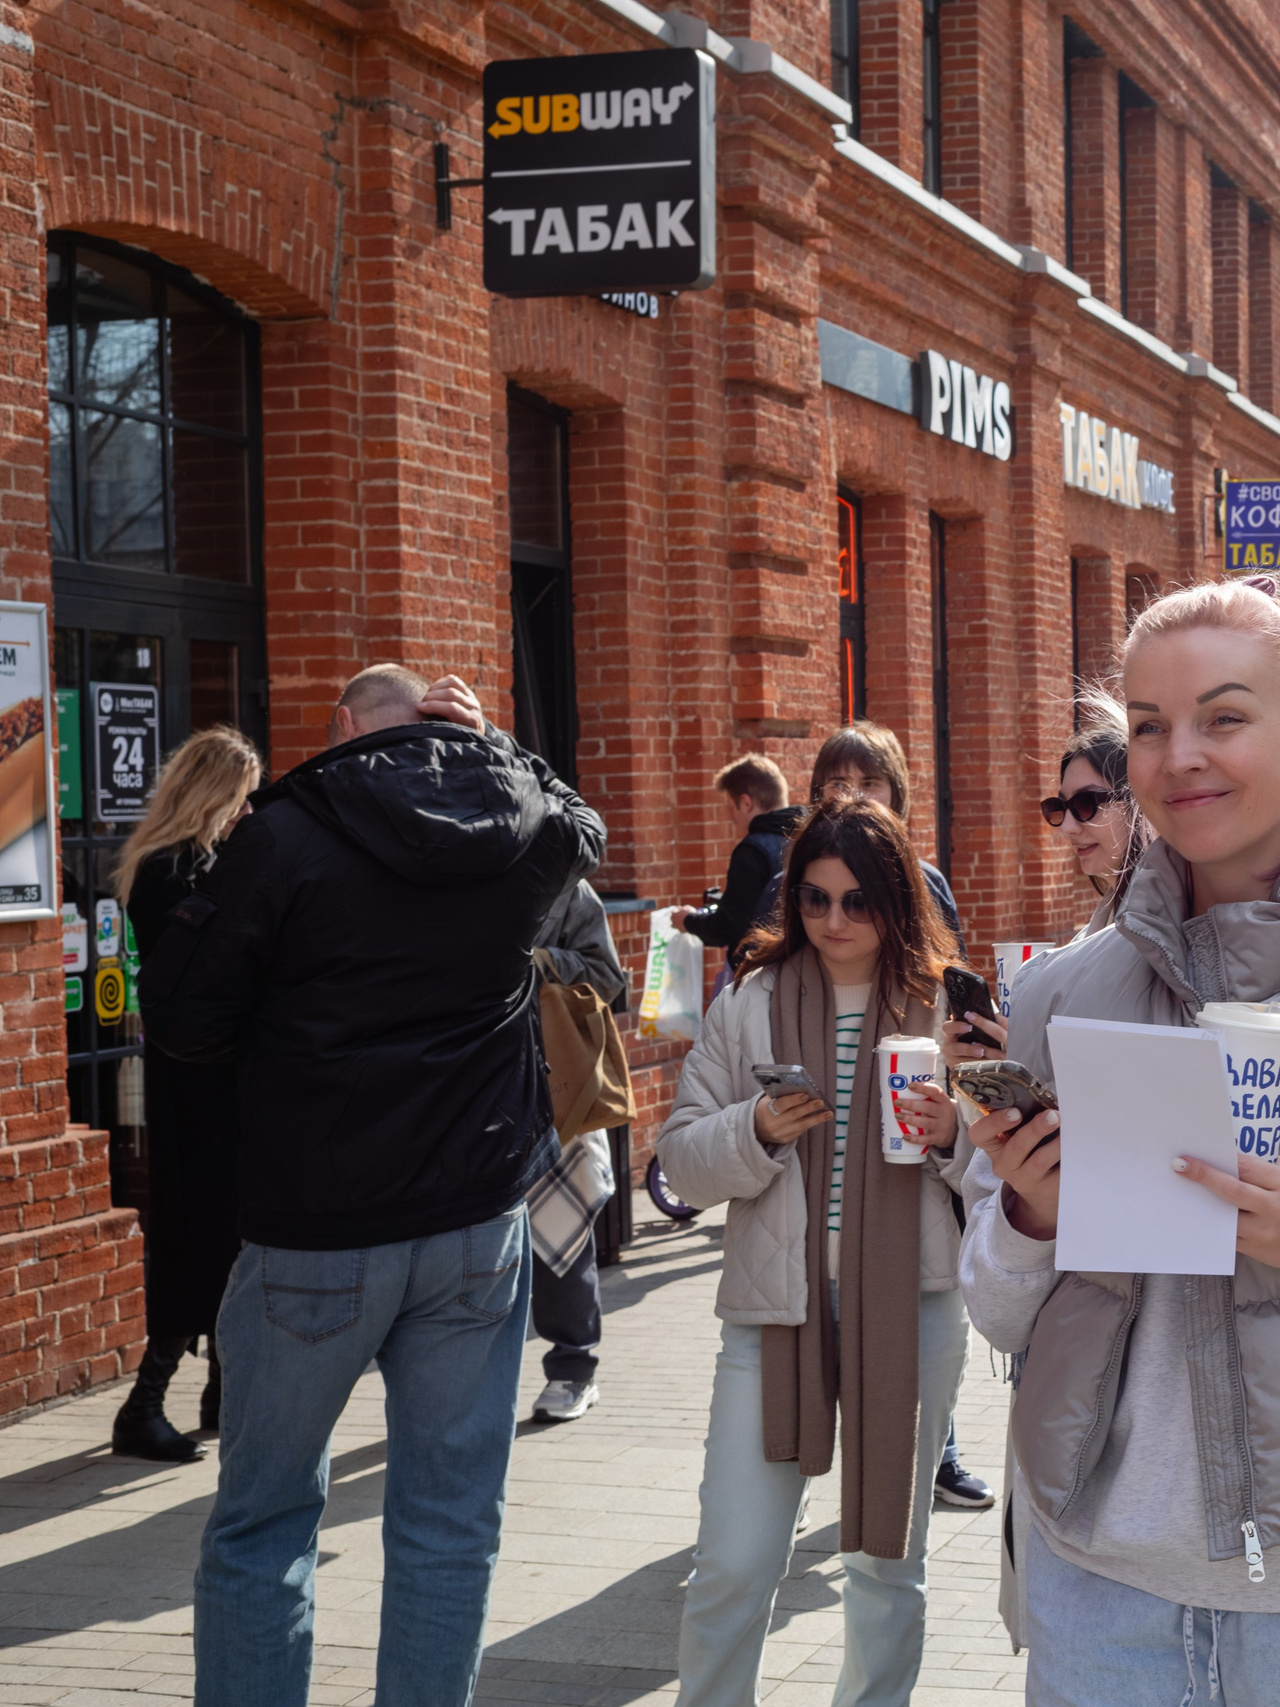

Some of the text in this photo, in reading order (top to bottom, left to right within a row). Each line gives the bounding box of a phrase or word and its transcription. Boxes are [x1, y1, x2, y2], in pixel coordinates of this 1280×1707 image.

[487, 82, 694, 140] SUBWAY
[487, 199, 696, 256] ТАБАК
[927, 349, 1012, 462] PIMS
[1059, 401, 1142, 511] ТАБАК
[112, 735, 145, 773] 24
[112, 772, 143, 788] часа
[23, 886, 39, 901] 35
